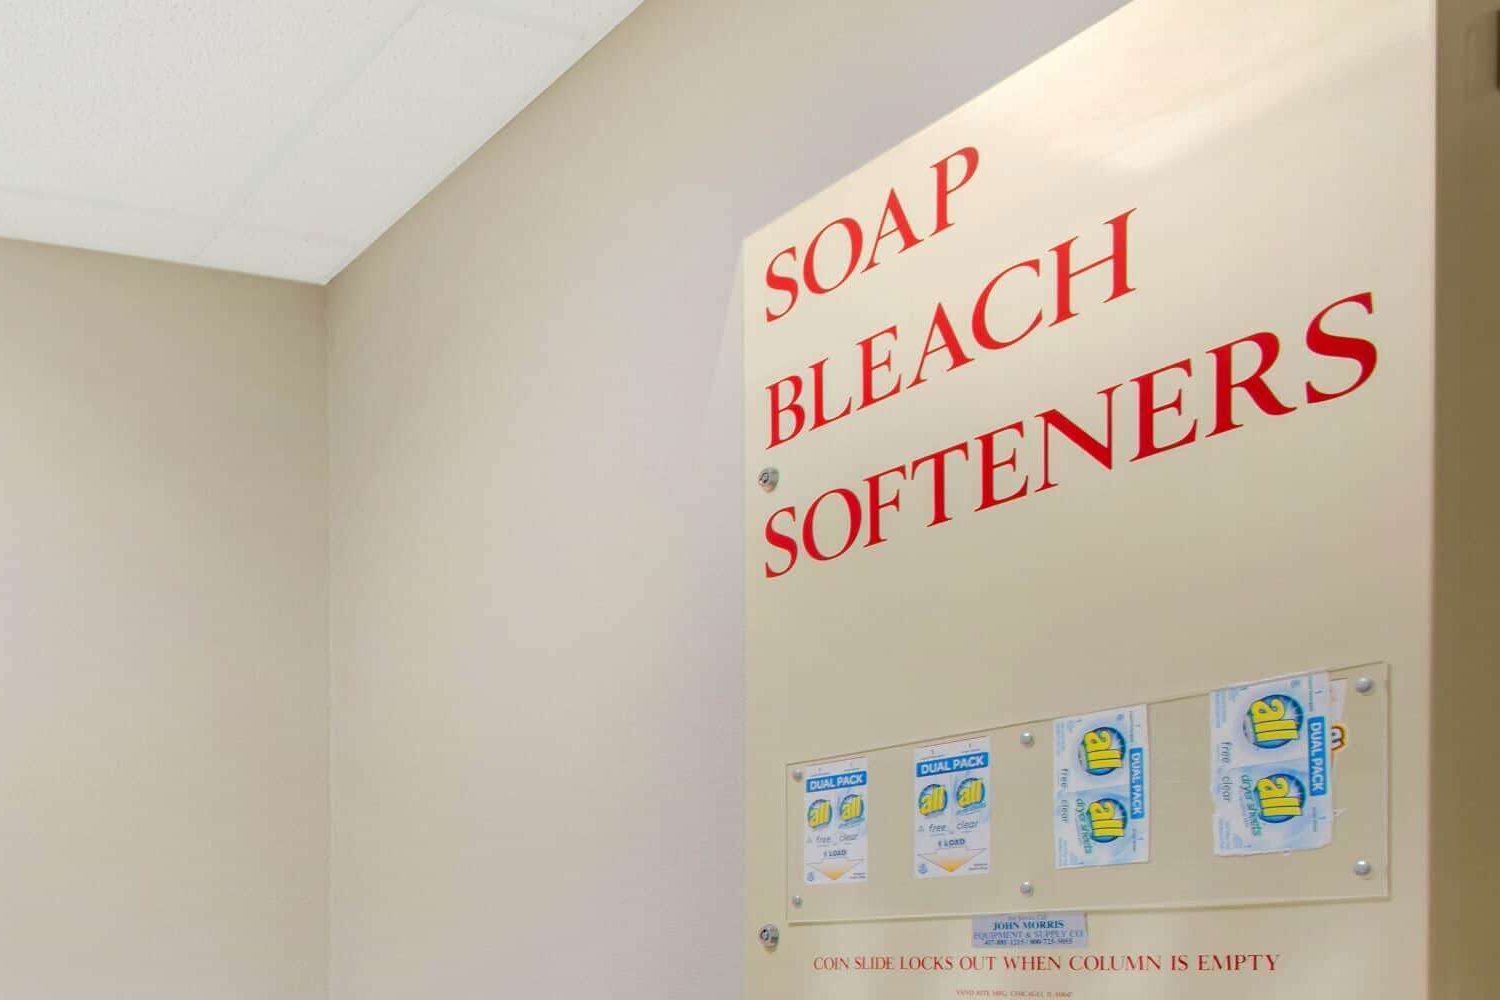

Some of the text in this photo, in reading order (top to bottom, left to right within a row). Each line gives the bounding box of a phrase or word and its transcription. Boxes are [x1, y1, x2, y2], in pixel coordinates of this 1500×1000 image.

[765, 146, 979, 323] SOAP
[765, 208, 1137, 450] BLEACH
[765, 291, 1377, 578] SOFTENERS
[1251, 698, 1299, 741] all
[1083, 731, 1123, 769] all
[1220, 742, 1232, 763] free
[1309, 722, 1322, 755] DUAL
[920, 755, 984, 775] DUAL PACK
[1131, 752, 1141, 783] DUAL
[1311, 758, 1324, 792] PACK
[809, 774, 863, 791] DUAL PACK
[957, 778, 983, 808] all
[1221, 776, 1233, 802] clear
[1255, 776, 1303, 817] all
[807, 800, 830, 828] all
[840, 795, 862, 821] all
[919, 784, 946, 815] all
[1132, 785, 1142, 816] PACK
[1240, 774, 1263, 837] dryer sheets
[1088, 801, 1125, 838] all
[944, 838, 966, 848] LOAD
[993, 920, 1065, 930] JOHN MORRIS
[1034, 929, 1068, 939] SUPPLY
[813, 955, 1281, 972] COIN SLIDE LOCKS OUT WHEN COLUMN IS EMPTY
